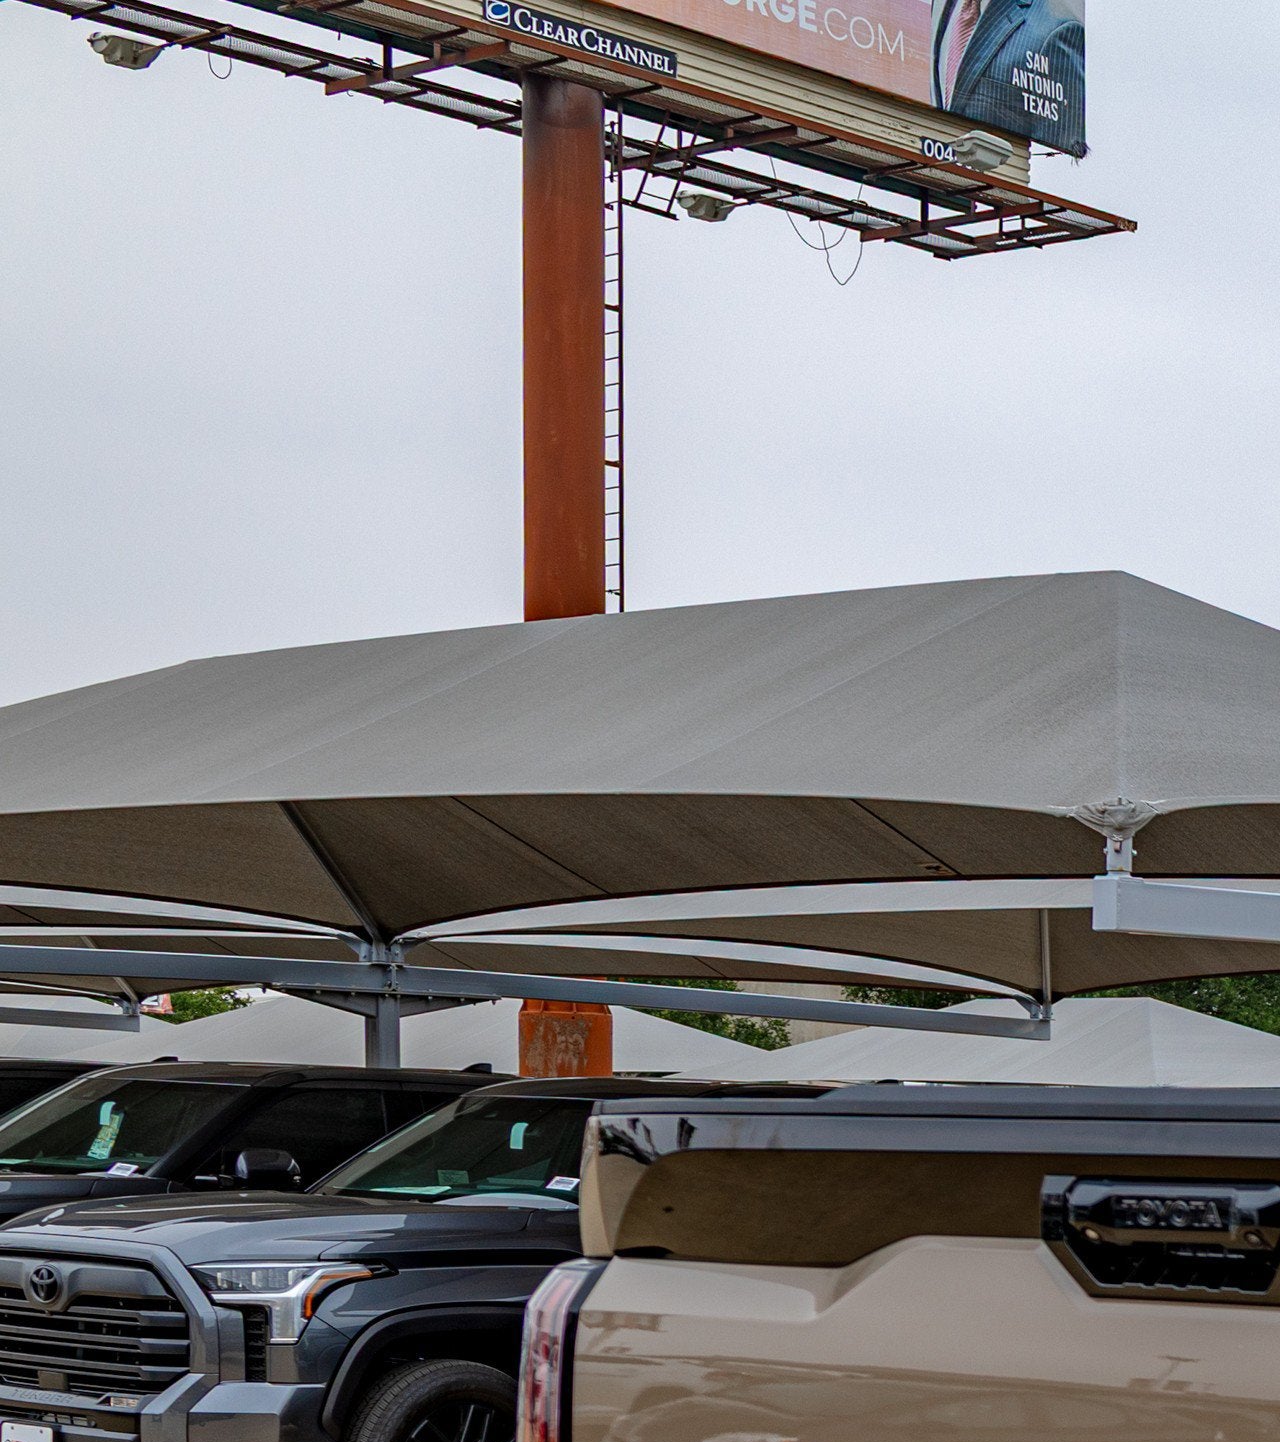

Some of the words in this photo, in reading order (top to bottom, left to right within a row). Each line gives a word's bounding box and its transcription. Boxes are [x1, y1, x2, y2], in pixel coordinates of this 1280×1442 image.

[721, 0, 905, 61] RGE.COM
[1026, 51, 1049, 75] SAN
[1012, 67, 1068, 106] ANTONIO,
[1022, 92, 1059, 122] TEXAS
